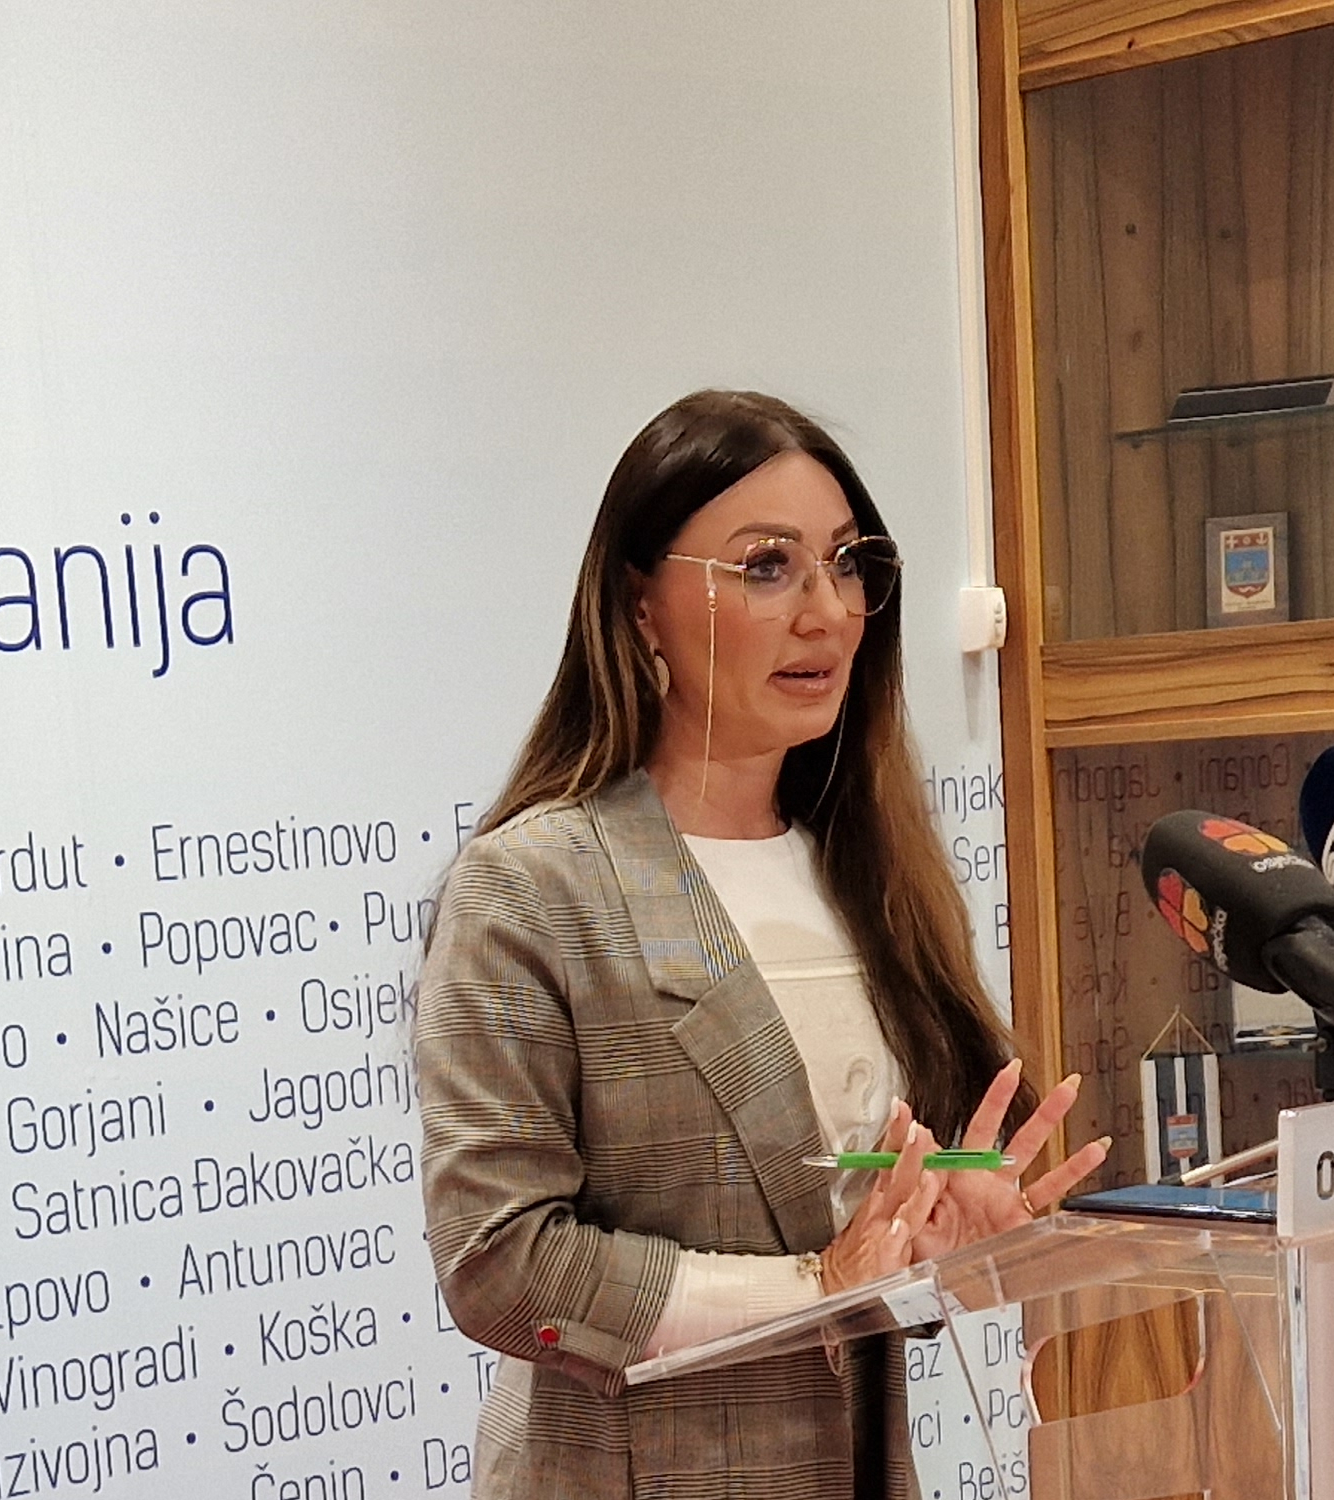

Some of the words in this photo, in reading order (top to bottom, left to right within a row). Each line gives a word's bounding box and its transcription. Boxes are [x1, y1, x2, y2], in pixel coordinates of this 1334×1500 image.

[152, 816, 396, 881] Ernestinovo
[139, 910, 317, 976] Popovac
[95, 994, 239, 1058] Našice
[7, 1081, 165, 1157] Gorjani
[249, 1050, 419, 1130] Jagodnj
[12, 1170, 183, 1239] Satnica
[192, 1135, 413, 1213] Đakovačka
[179, 1225, 395, 1299] Antunovac
[259, 1301, 377, 1366] Koška
[222, 1366, 415, 1452] Šodolovci
